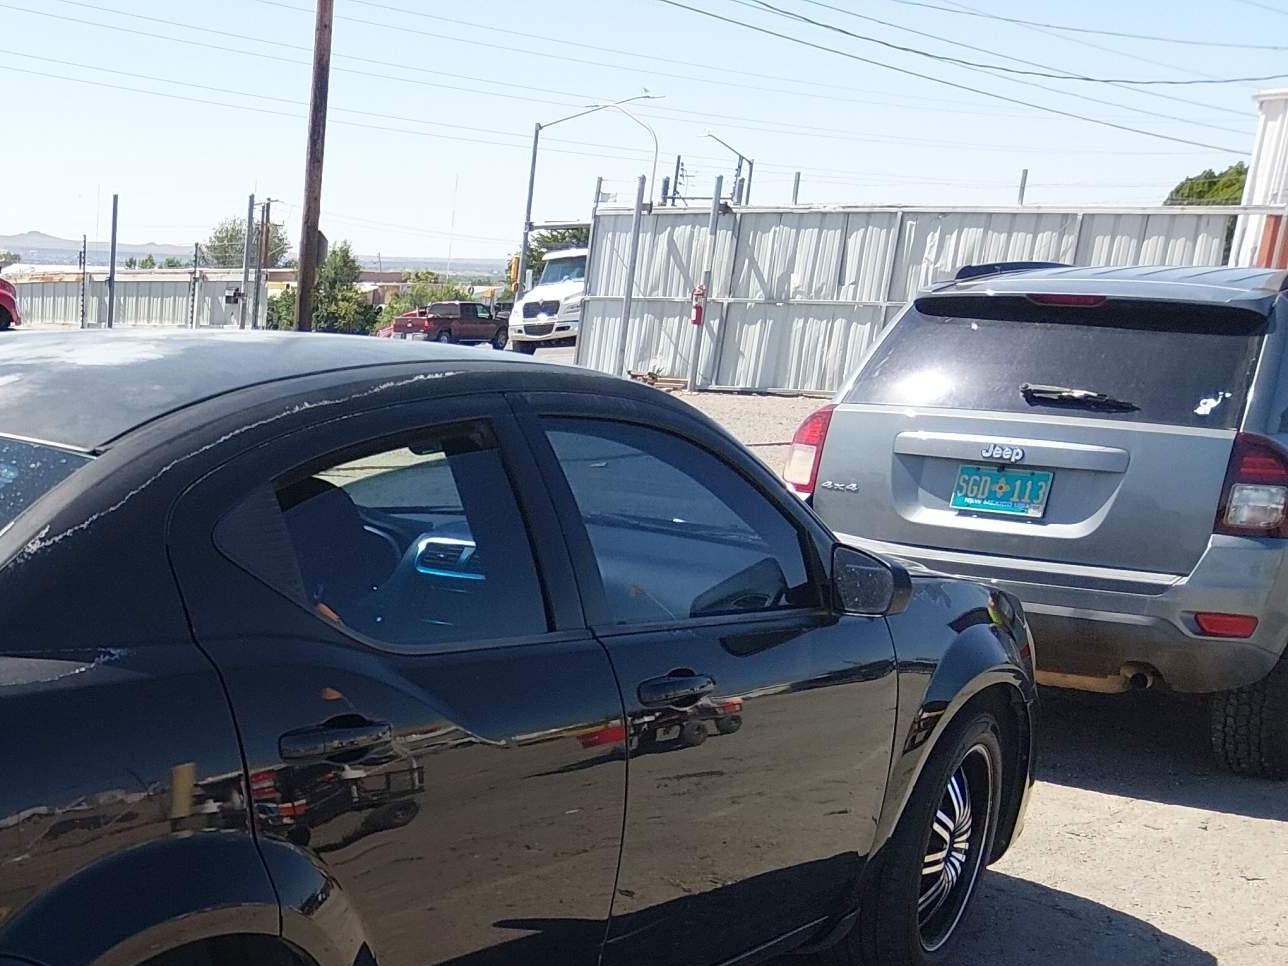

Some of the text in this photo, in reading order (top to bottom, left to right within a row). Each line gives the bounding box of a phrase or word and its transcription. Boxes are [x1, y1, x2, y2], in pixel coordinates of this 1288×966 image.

[981, 444, 1024, 462] Jeep
[957, 475, 1046, 504] SGD 113
